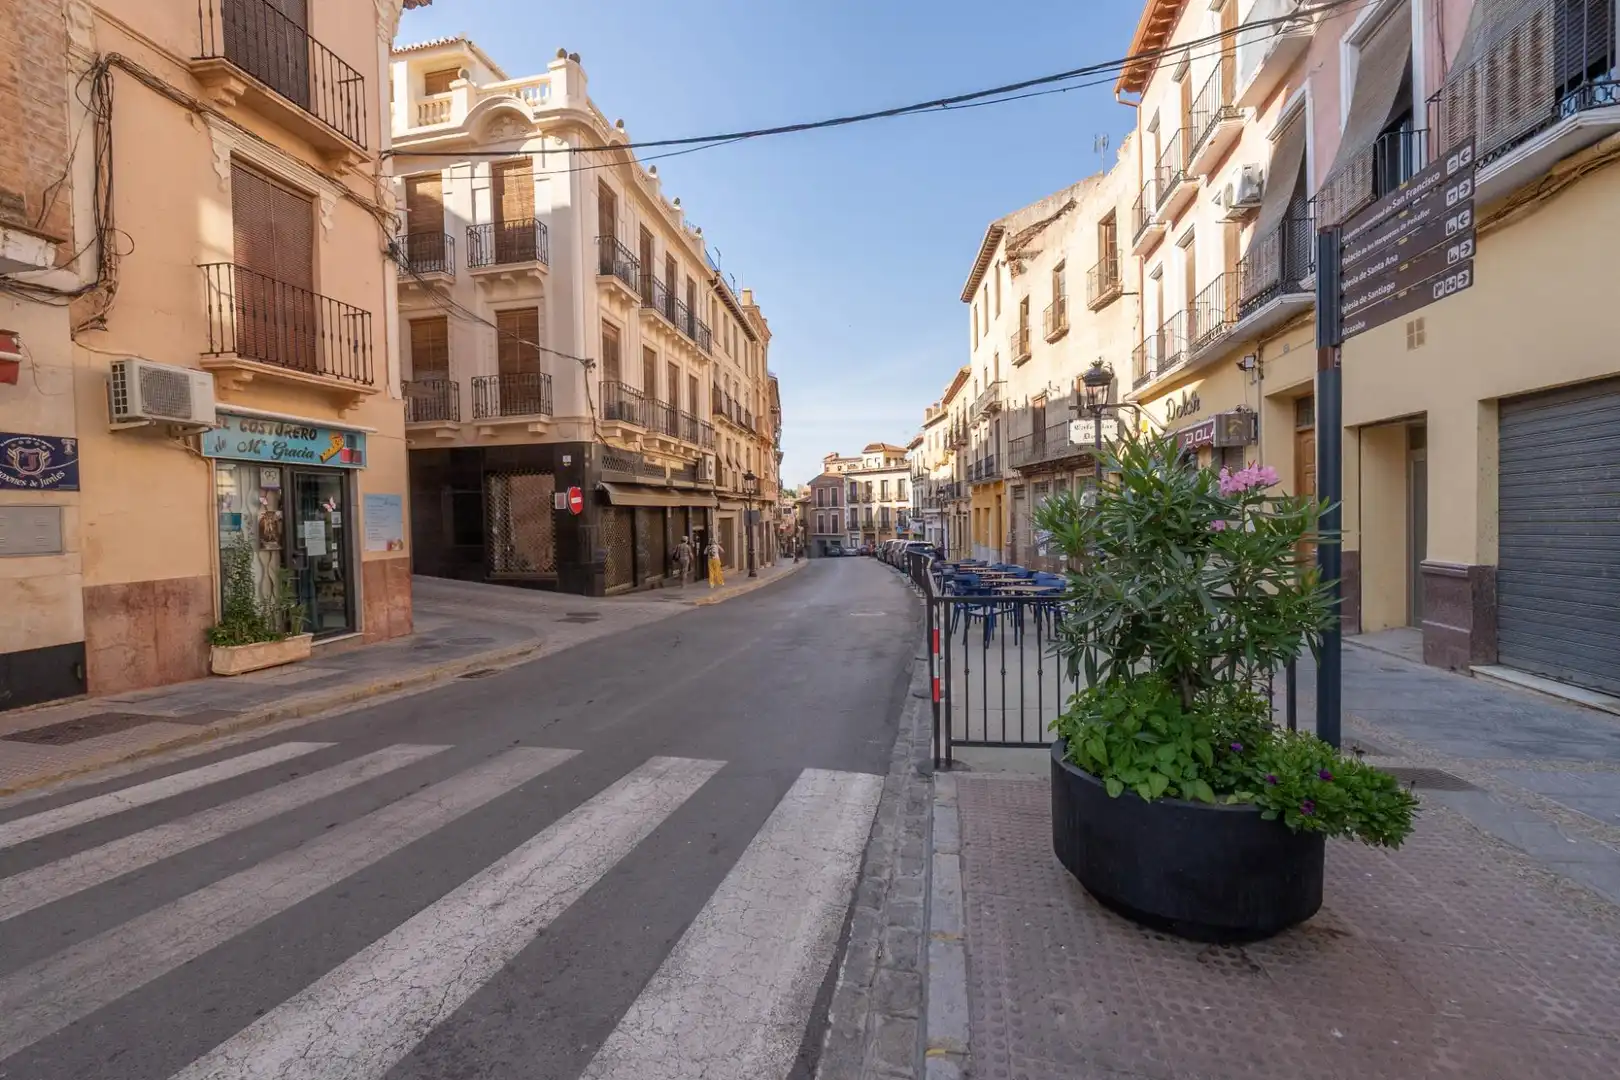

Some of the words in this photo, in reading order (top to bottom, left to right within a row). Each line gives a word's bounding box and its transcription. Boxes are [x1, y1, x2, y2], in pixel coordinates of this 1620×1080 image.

[1392, 195, 1405, 209] San
[1405, 171, 1441, 200] Francisco
[1341, 248, 1361, 266] Palacio
[1341, 275, 1359, 292] Iglesia
[1367, 262, 1384, 276] Santa
[1385, 254, 1399, 267] Ana
[1341, 299, 1359, 315] Iglesia
[1367, 282, 1396, 300] Santiago
[1341, 320, 1366, 337] Alcazaba
[239, 418, 317, 441] COSTURERO
[214, 435, 227, 453] de
[271, 440, 314, 460] Gracia
